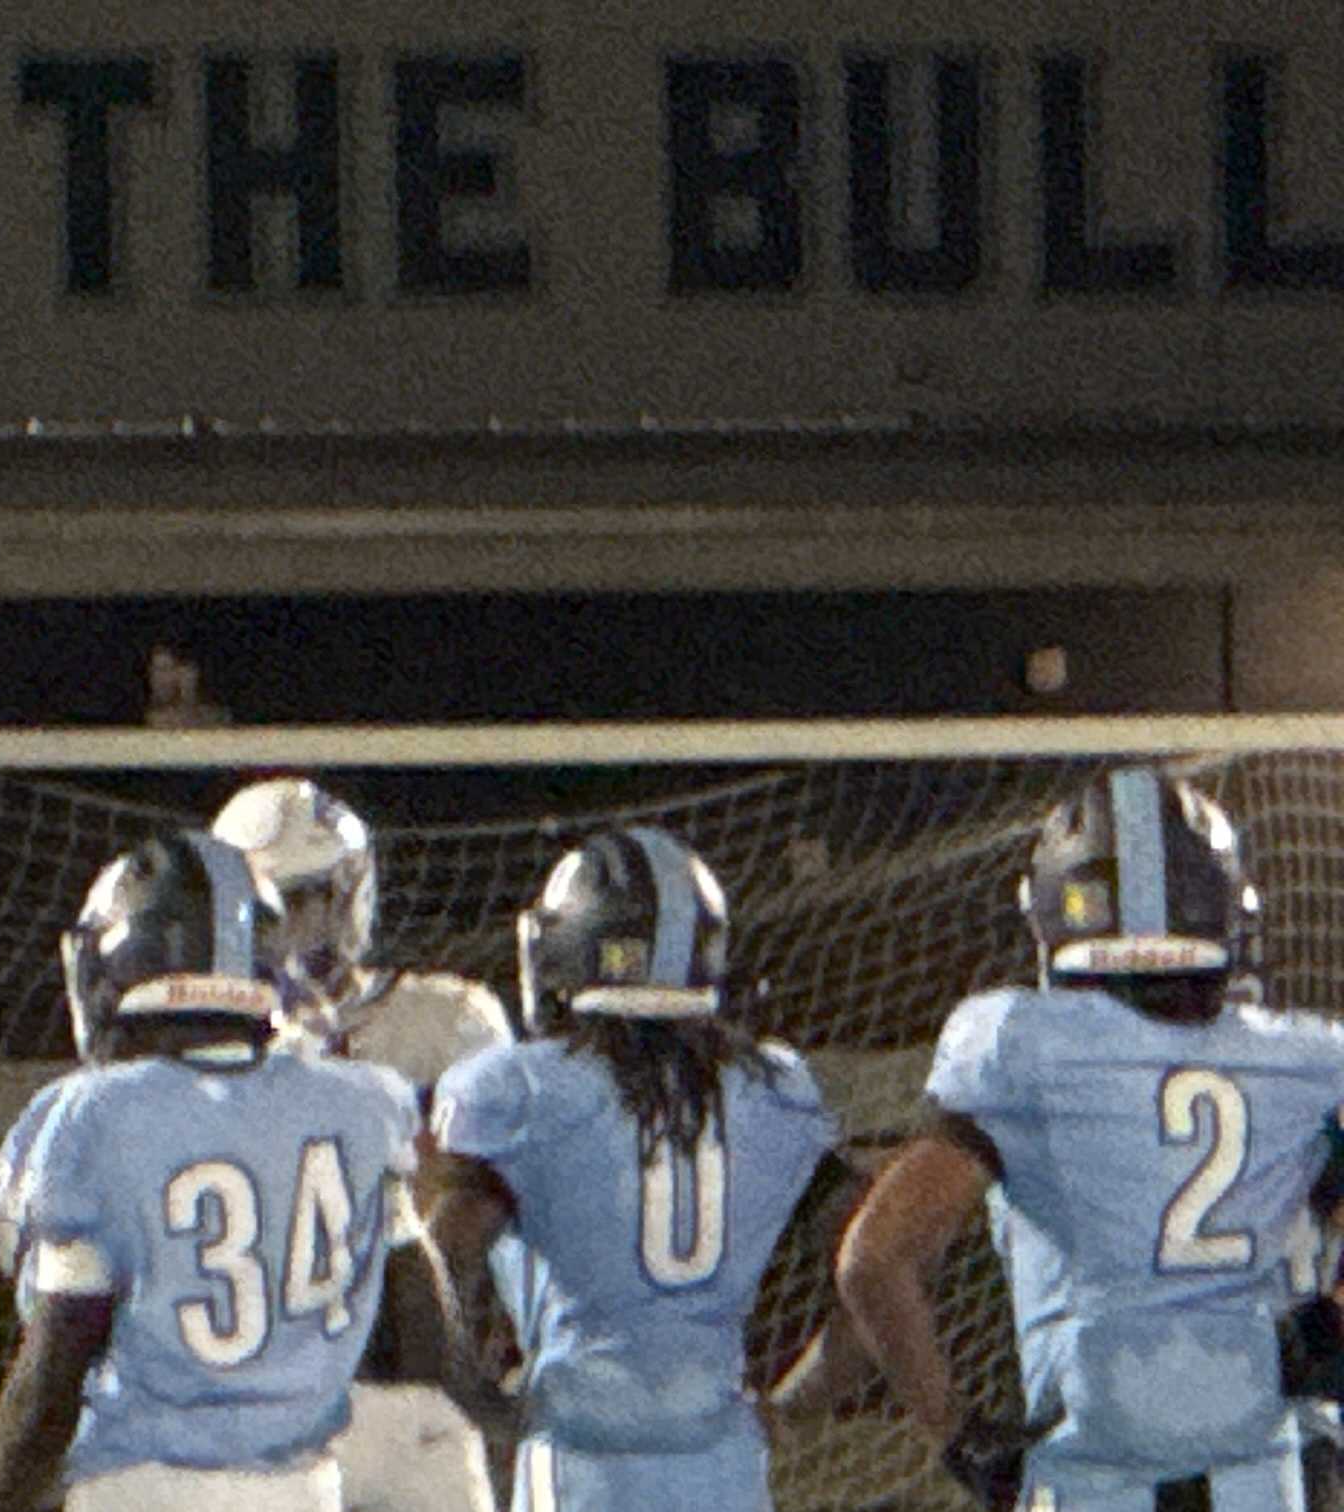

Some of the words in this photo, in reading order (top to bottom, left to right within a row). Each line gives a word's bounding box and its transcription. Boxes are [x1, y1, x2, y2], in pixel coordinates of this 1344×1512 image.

[16, 54, 533, 297] THE
[662, 53, 1344, 297] BULL
[166, 1137, 354, 1368] 34
[1156, 1068, 1255, 1275] 2
